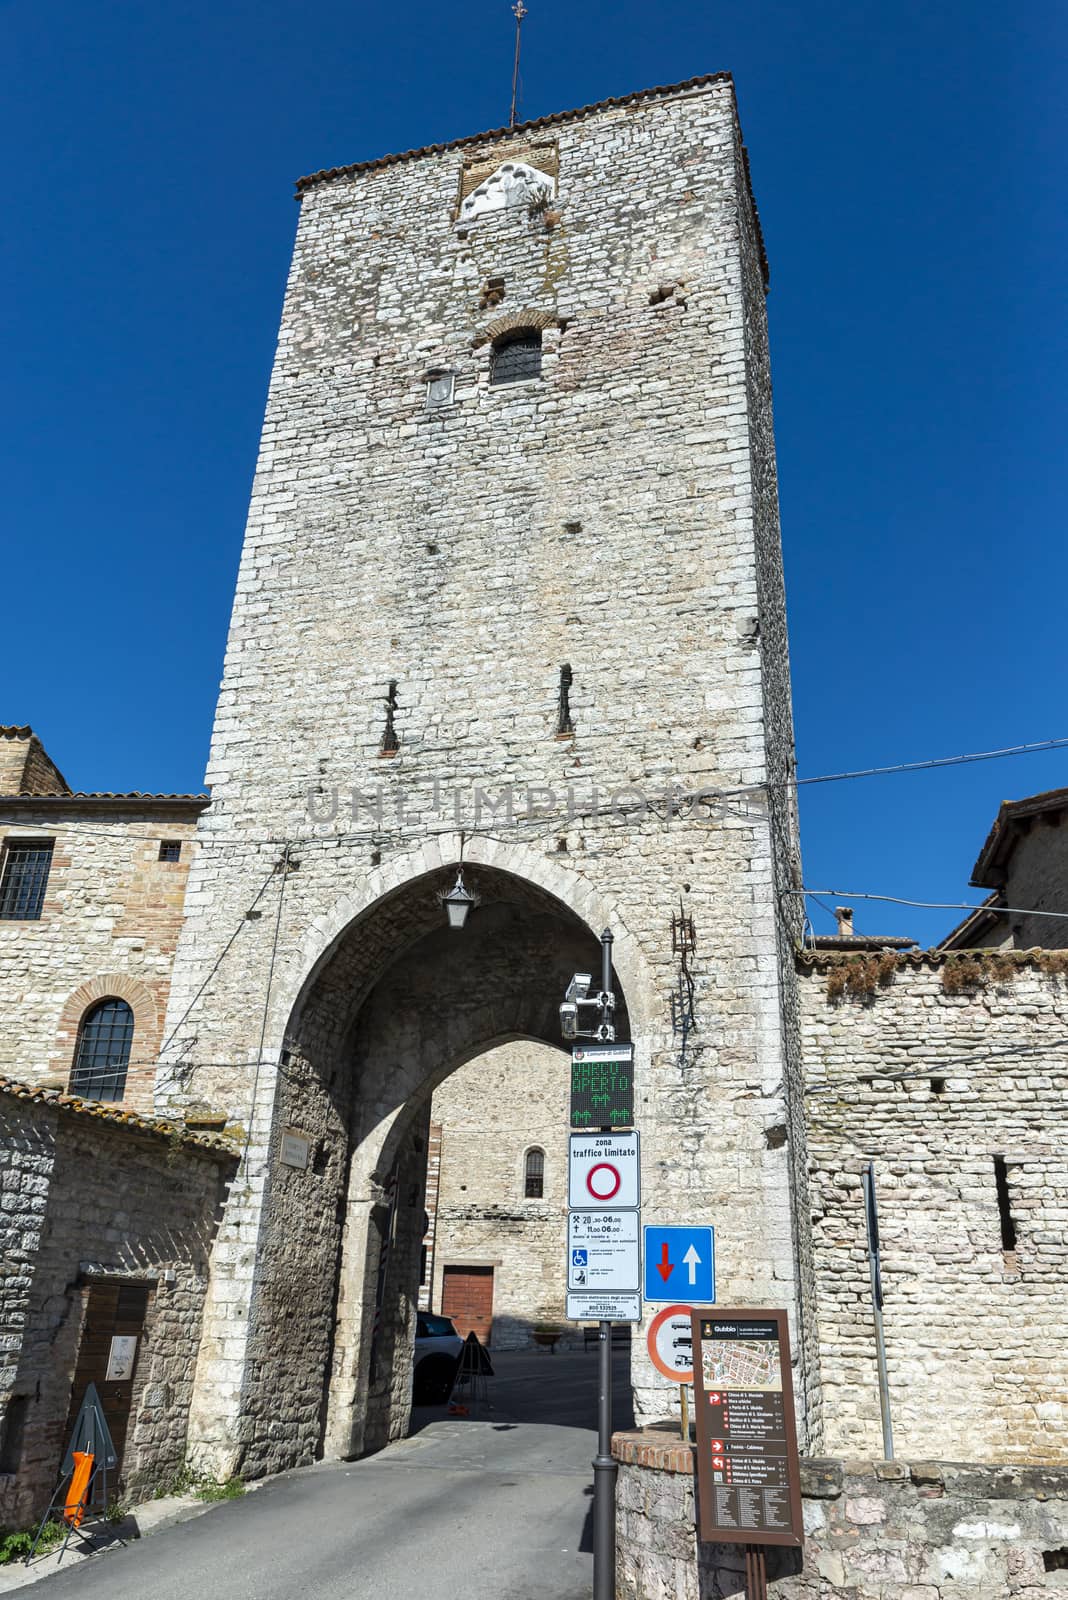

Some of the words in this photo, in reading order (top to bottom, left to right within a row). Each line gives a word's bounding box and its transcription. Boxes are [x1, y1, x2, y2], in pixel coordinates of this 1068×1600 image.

[572, 1076, 628, 1093] APERTO
[573, 1149, 602, 1158] traffico
[604, 1148, 636, 1157] limitato
